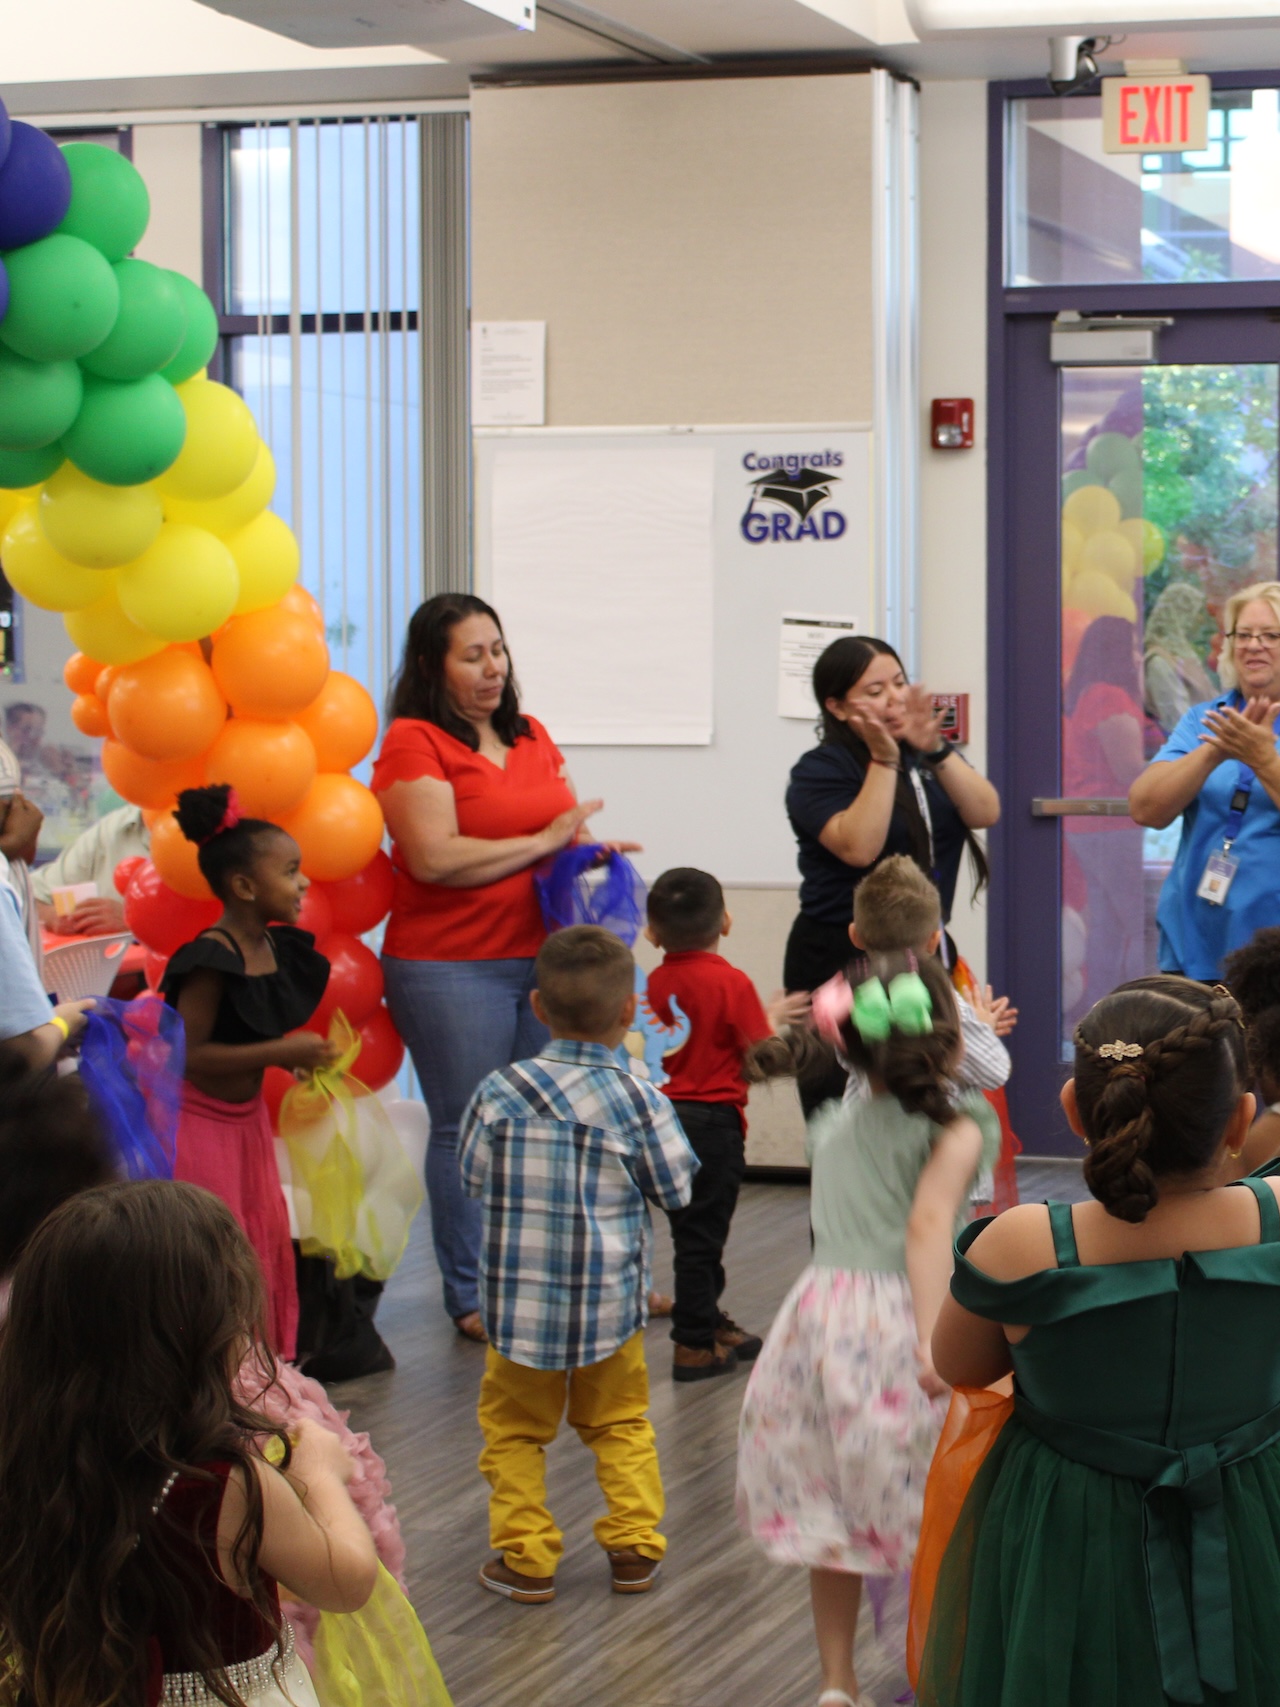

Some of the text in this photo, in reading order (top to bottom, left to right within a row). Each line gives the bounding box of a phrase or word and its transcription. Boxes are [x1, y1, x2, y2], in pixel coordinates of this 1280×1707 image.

[1120, 84, 1194, 144] EXIT
[743, 451, 844, 475] Congrats
[741, 511, 847, 543] GRAD
[931, 696, 957, 707] FIRE
